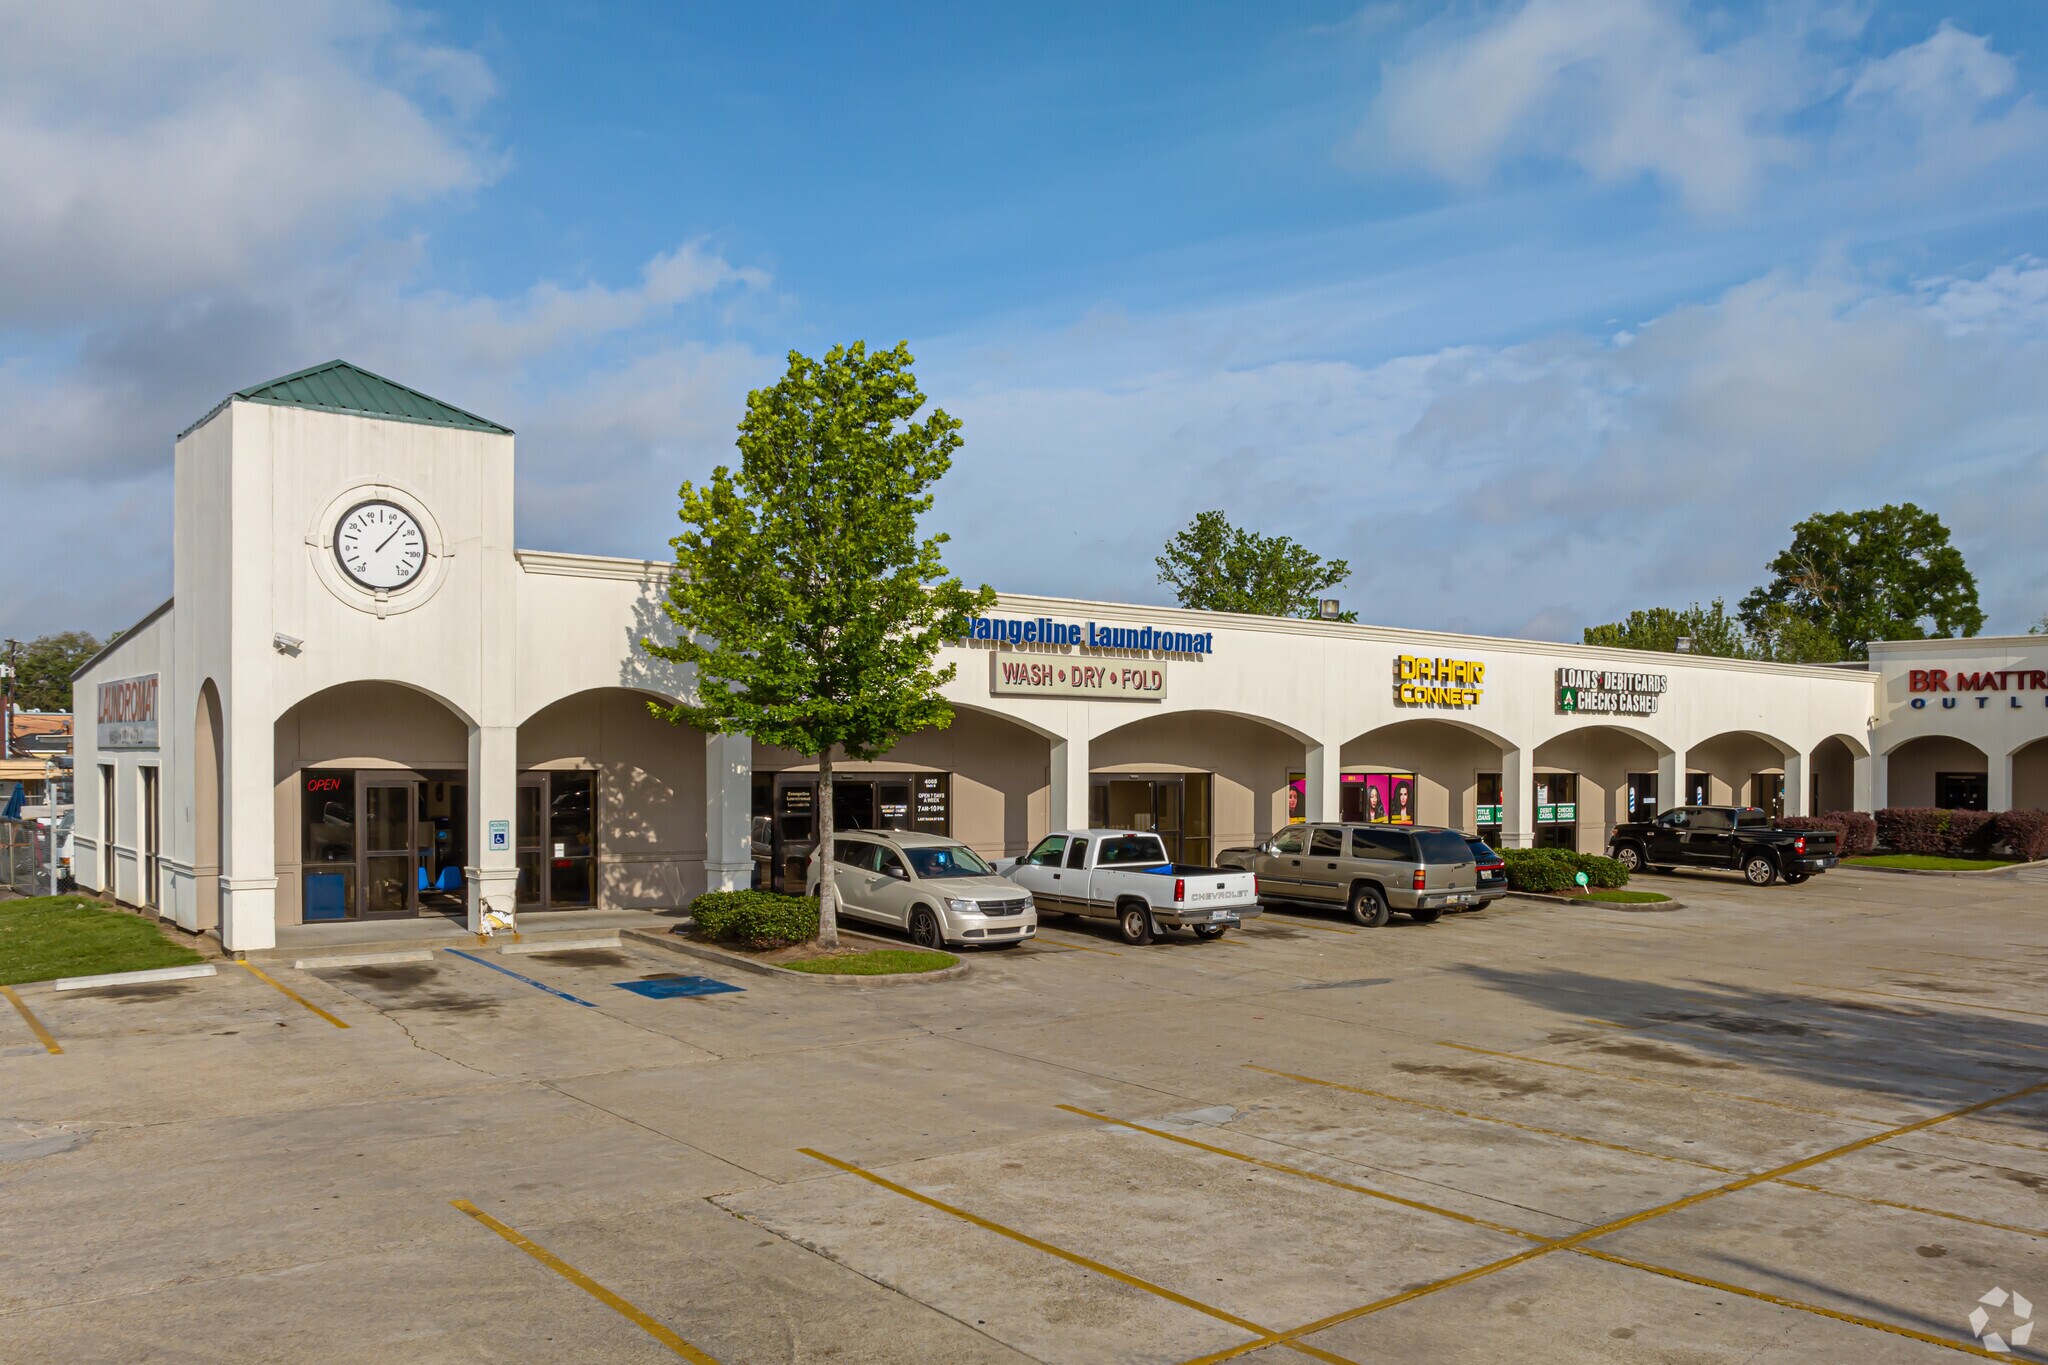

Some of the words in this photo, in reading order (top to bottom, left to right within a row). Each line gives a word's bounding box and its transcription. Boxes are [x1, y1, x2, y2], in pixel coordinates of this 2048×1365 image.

[960, 617, 1081, 645] vangeline
[1088, 621, 1213, 654] Laundromat
[1002, 661, 1053, 686] WASH
[1071, 665, 1106, 688] DRY
[1121, 668, 1163, 691] FOLD
[1400, 654, 1432, 681] DA
[1437, 657, 1485, 684] HAIR
[1561, 668, 1599, 689] LOANS
[1604, 671, 1634, 692] DEBIT
[1634, 673, 1668, 693] CARDS
[1909, 669, 1950, 692] BR
[1957, 670, 2048, 691] MATTR
[97, 678, 158, 724] LAUNDROMAT
[1400, 683, 1484, 705] CONNECT
[1577, 691, 1618, 711] CHECKS
[1619, 693, 1658, 713] CASHED
[1910, 696, 2048, 709] OUTL
[308, 778, 340, 792] OPEN
[1191, 890, 1248, 902] CHEVROLET
